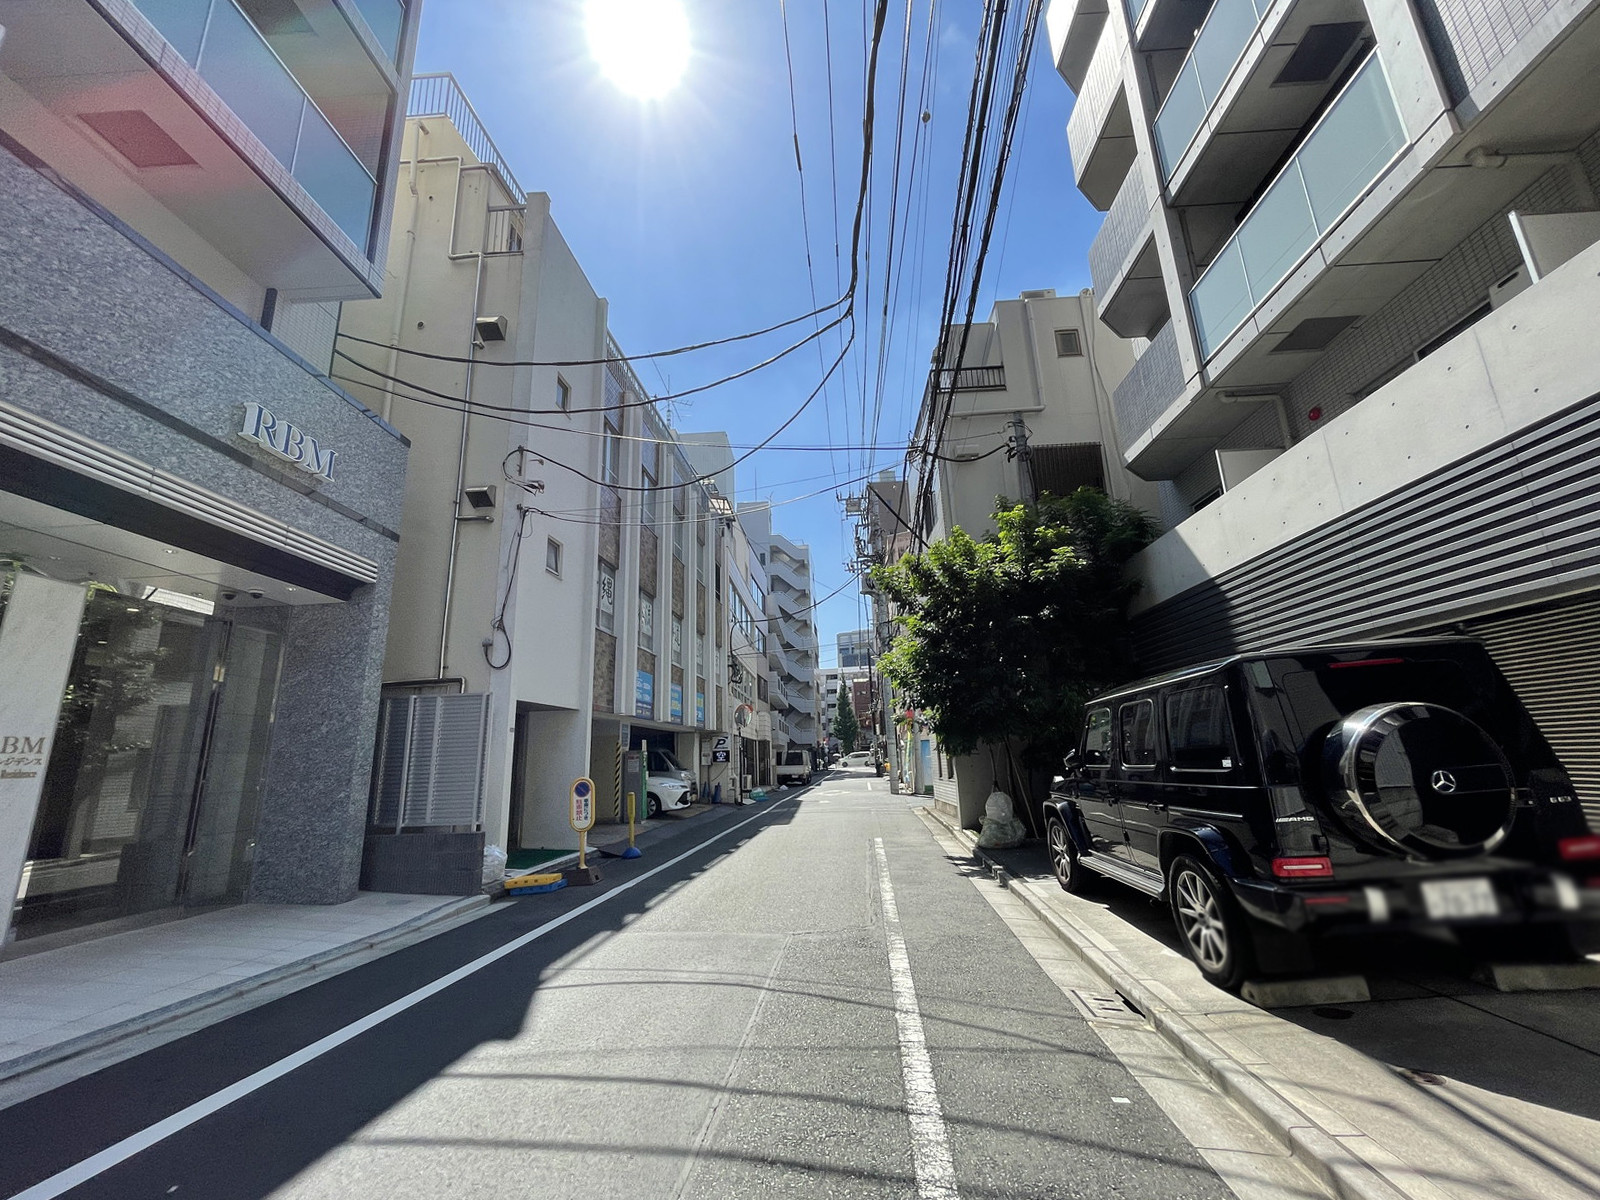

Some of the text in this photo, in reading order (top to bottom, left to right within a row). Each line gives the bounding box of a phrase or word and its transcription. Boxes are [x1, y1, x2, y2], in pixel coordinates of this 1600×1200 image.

[238, 402, 339, 482] RBM
[0, 736, 46, 754] BM
[714, 738, 726, 749] P
[716, 751, 727, 762] 空
